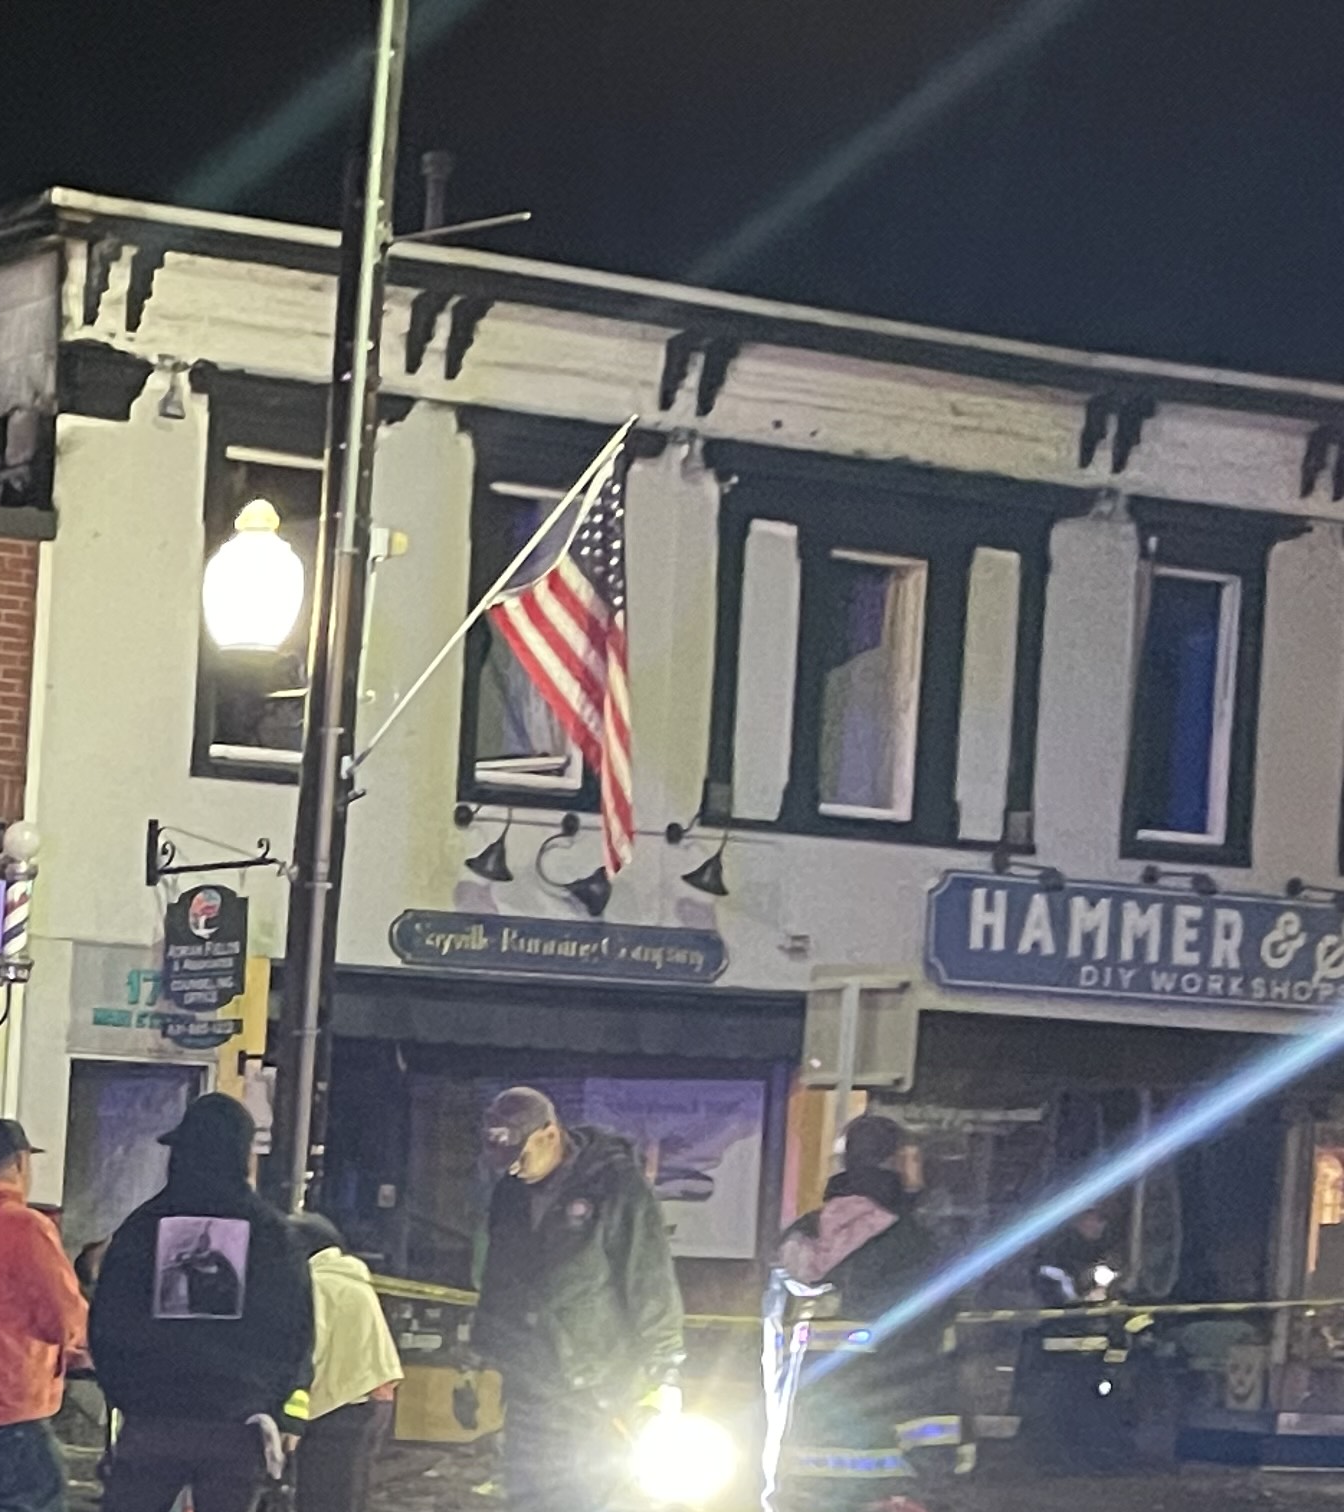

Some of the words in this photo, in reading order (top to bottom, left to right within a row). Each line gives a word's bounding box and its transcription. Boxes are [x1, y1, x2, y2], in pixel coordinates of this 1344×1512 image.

[968, 887, 1245, 970] HAMMER
[1260, 911, 1308, 970] &
[1078, 964, 1138, 990] DIY
